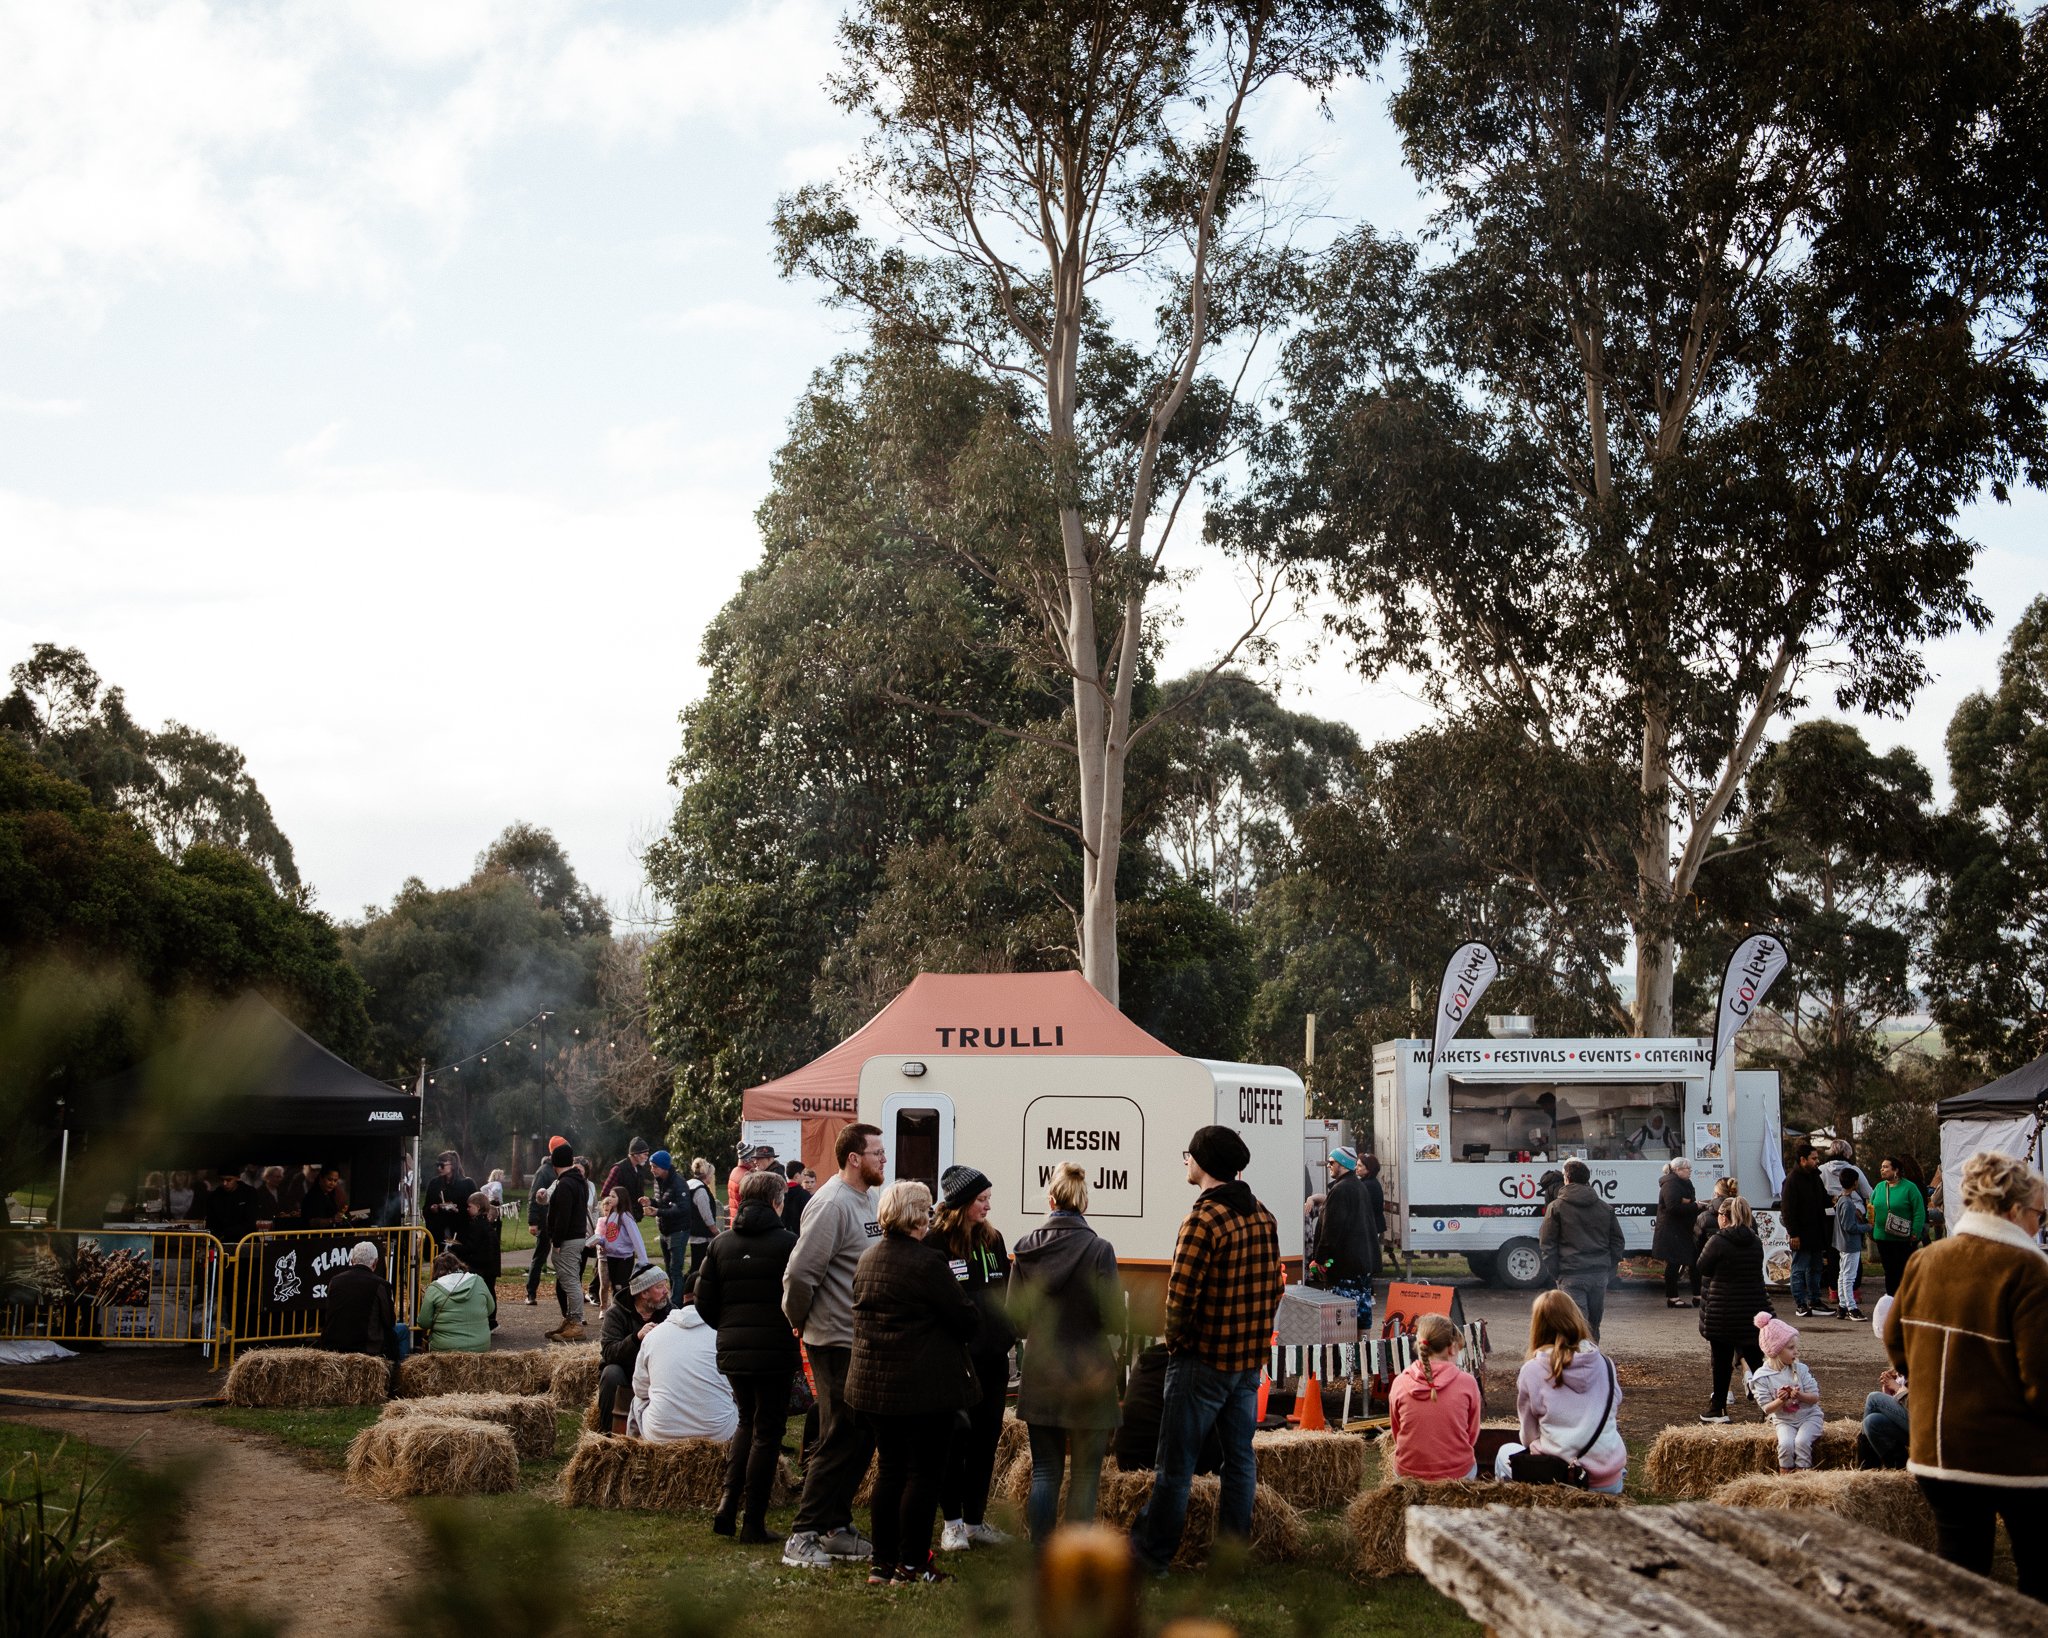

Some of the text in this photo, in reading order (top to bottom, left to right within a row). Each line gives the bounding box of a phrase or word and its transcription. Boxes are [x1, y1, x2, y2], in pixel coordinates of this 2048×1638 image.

[935, 1025, 1064, 1048] TRULLI
[1494, 1050, 1566, 1063] FESTIVALS
[1578, 1050, 1632, 1063] EVENTS
[792, 1097, 858, 1112] SOUTHE
[1239, 1086, 1283, 1126] COFFEE
[368, 1111, 404, 1121] ALTEGRA
[1046, 1127, 1120, 1151] MESSIN
[1093, 1167, 1128, 1190] JIM
[1595, 1167, 1617, 1177] fresh
[1507, 1205, 1538, 1216] TASTY
[1614, 1204, 1647, 1215] zleme
